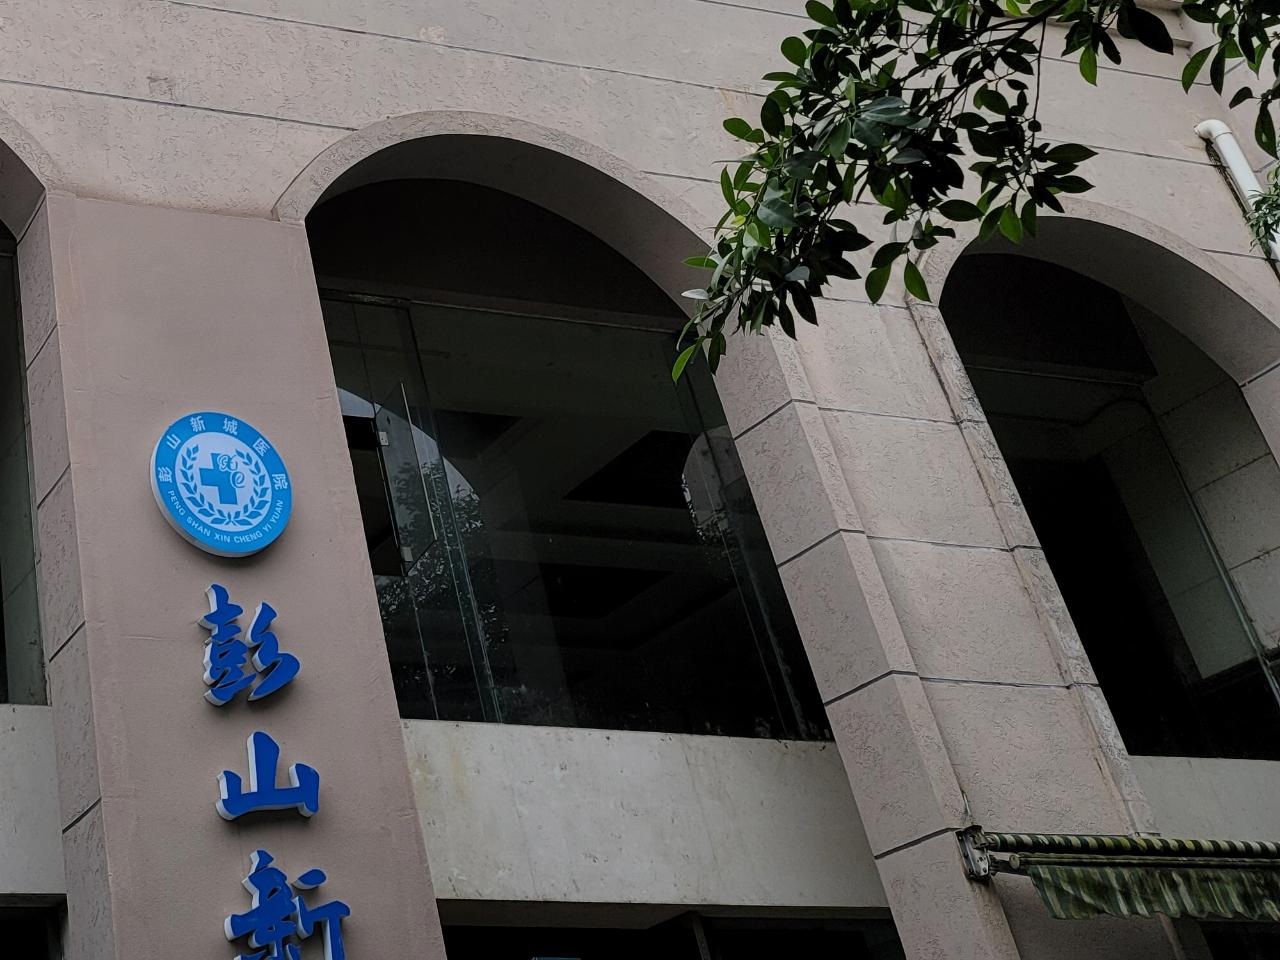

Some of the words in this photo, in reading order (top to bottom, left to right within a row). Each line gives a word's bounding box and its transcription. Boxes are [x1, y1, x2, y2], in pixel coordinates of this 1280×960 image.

[157, 415, 288, 491] 彭山新城医院
[169, 490, 185, 516] PENG
[186, 516, 211, 537] SHAN
[214, 533, 231, 543] XIN
[233, 531, 263, 544] CHENG
[263, 523, 273, 534] YI
[270, 499, 284, 524] YUAN
